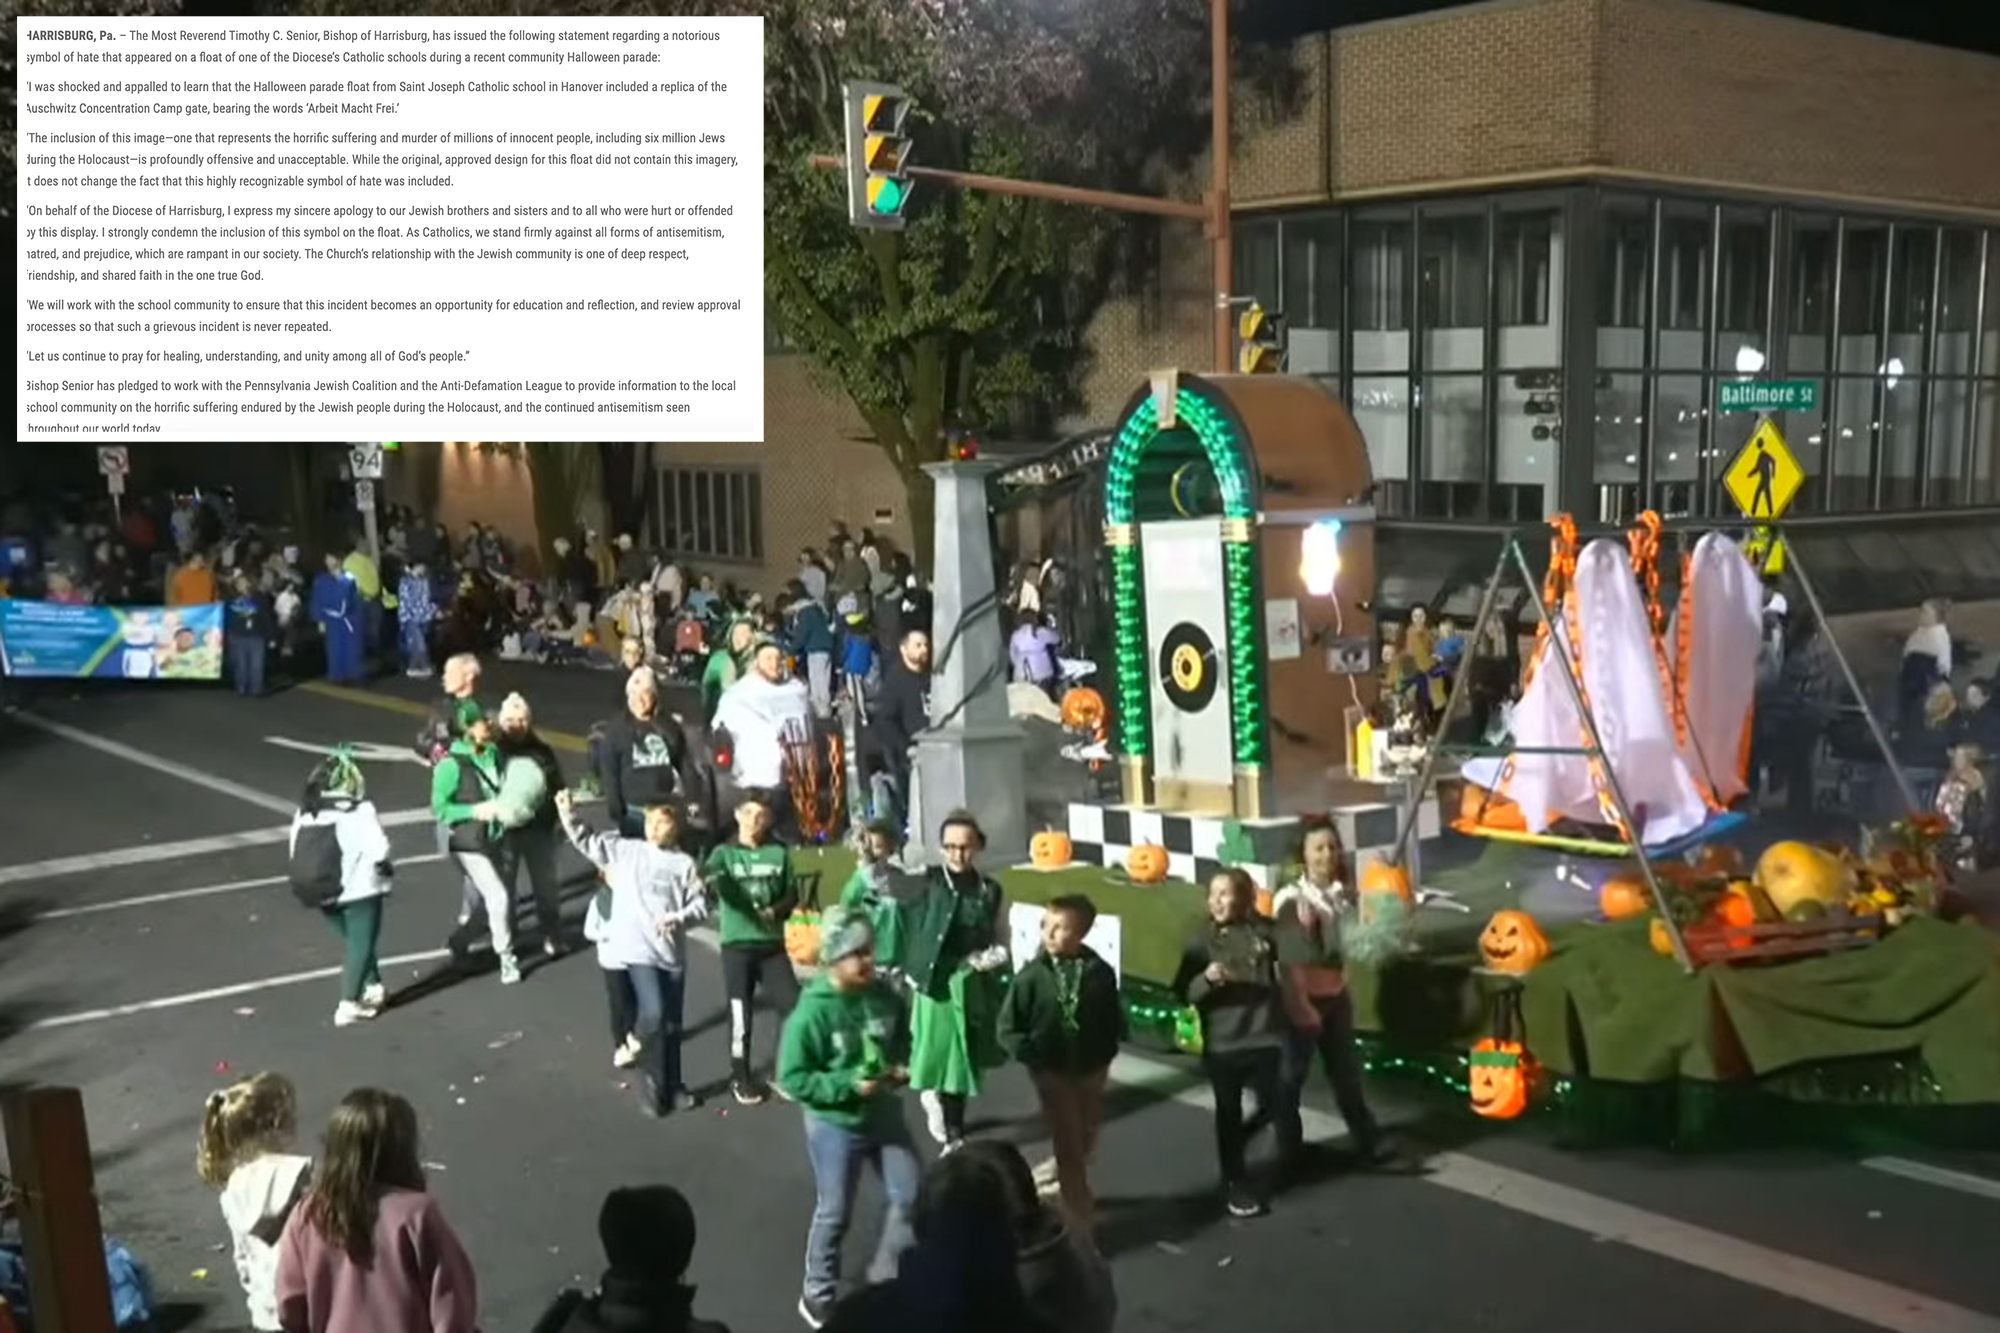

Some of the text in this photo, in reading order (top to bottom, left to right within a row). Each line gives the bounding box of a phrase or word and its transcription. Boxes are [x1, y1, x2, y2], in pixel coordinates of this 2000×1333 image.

[1721, 385, 1813, 404] Baltimore St
[353, 451, 380, 470] 94
